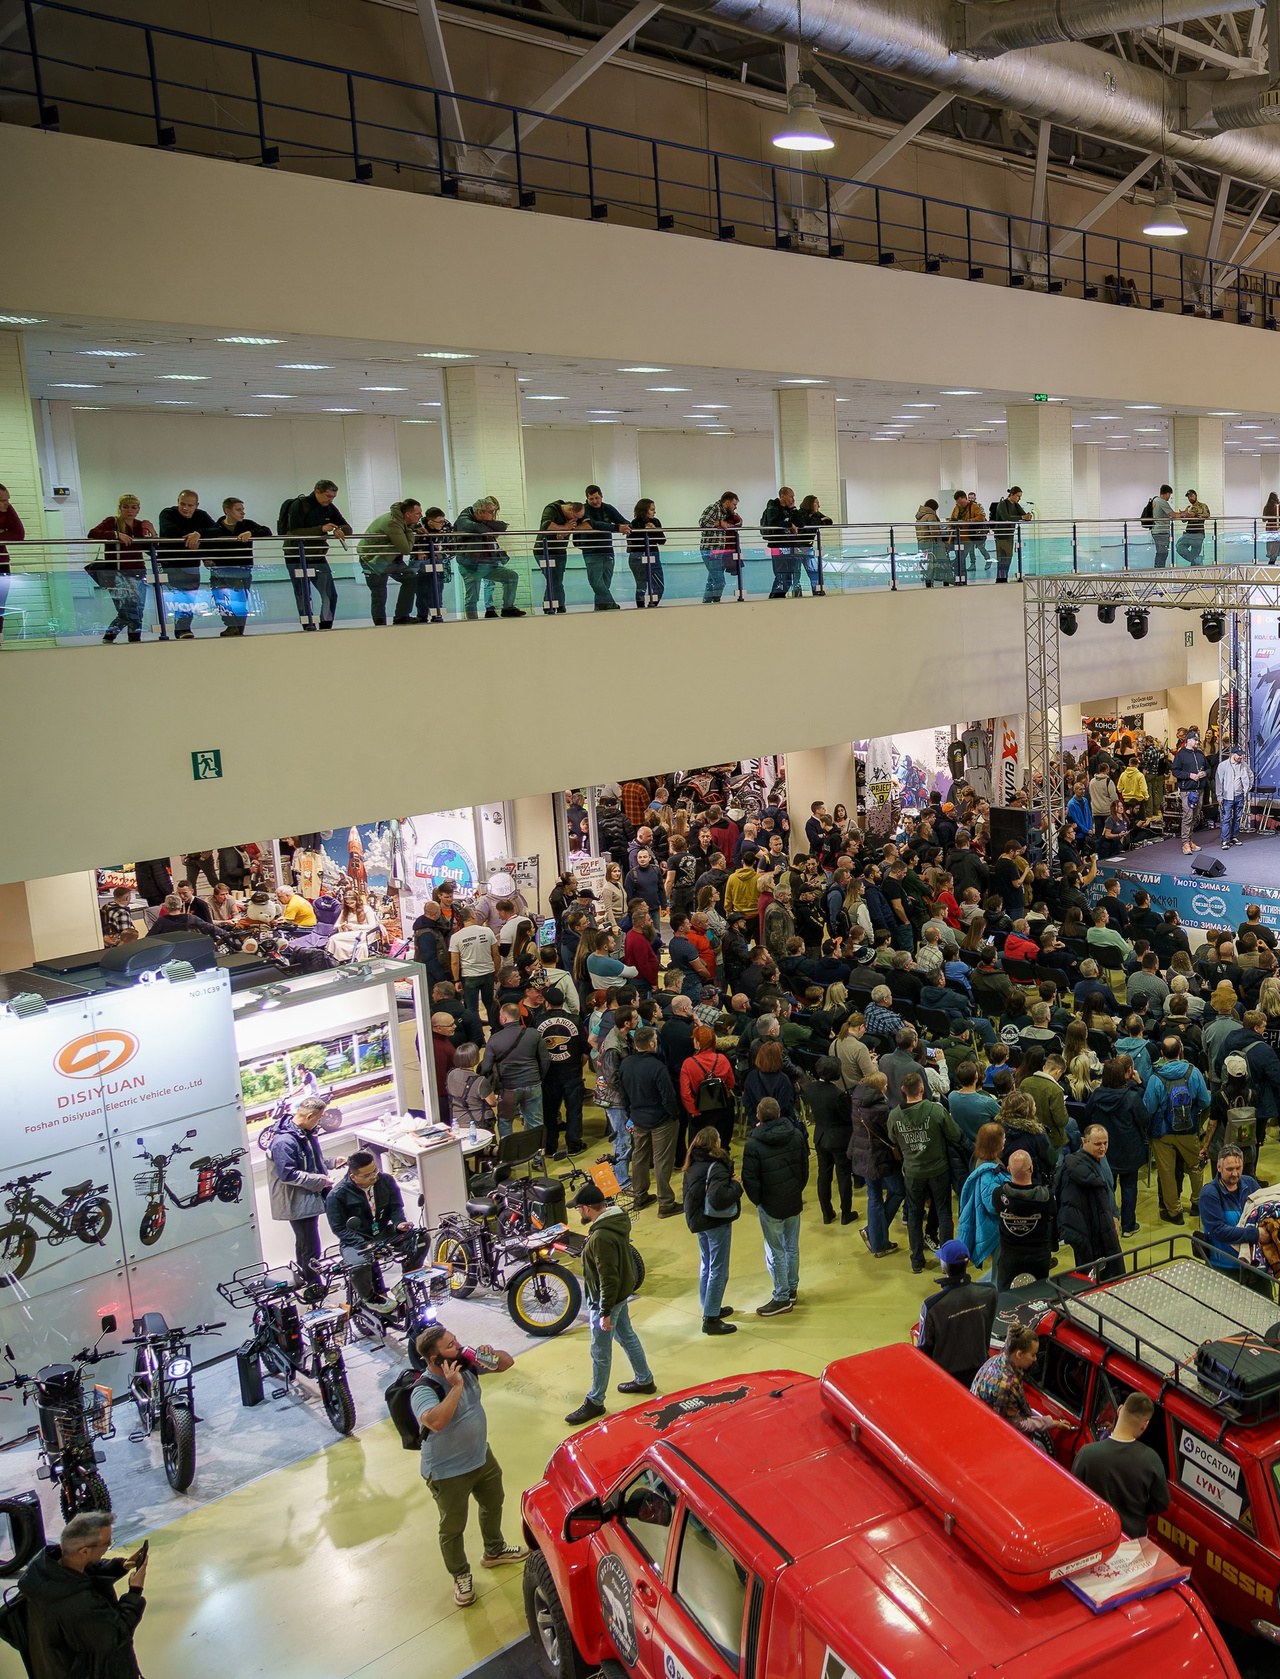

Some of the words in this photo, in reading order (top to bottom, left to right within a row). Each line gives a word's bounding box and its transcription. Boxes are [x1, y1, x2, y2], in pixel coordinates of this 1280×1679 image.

[416, 860, 439, 876] Iron
[441, 864, 464, 881] Butt
[1177, 879, 1197, 888] МОТО
[1199, 882, 1221, 891] ЗИМА
[1221, 884, 1230, 892] 24
[1200, 921, 1222, 931] ЗИМА
[539, 1019, 554, 1034] ELLS
[555, 1018, 579, 1036] ANGELS
[57, 1074, 146, 1109] DISIYUAN
[24, 1118, 60, 1134] Foshan
[62, 1106, 102, 1126] Disiyuan
[105, 1096, 138, 1112] Electric
[139, 1087, 172, 1102] Vehicle
[173, 1078, 203, 1094] Co.,Ltd
[38, 1203, 62, 1223] DISIYUAN
[1194, 1445, 1237, 1481] РОСАТОМ
[1195, 1474, 1226, 1500] LYNX
[1065, 1553, 1101, 1572] EVEREST
[1206, 1548, 1274, 1607] USSR
